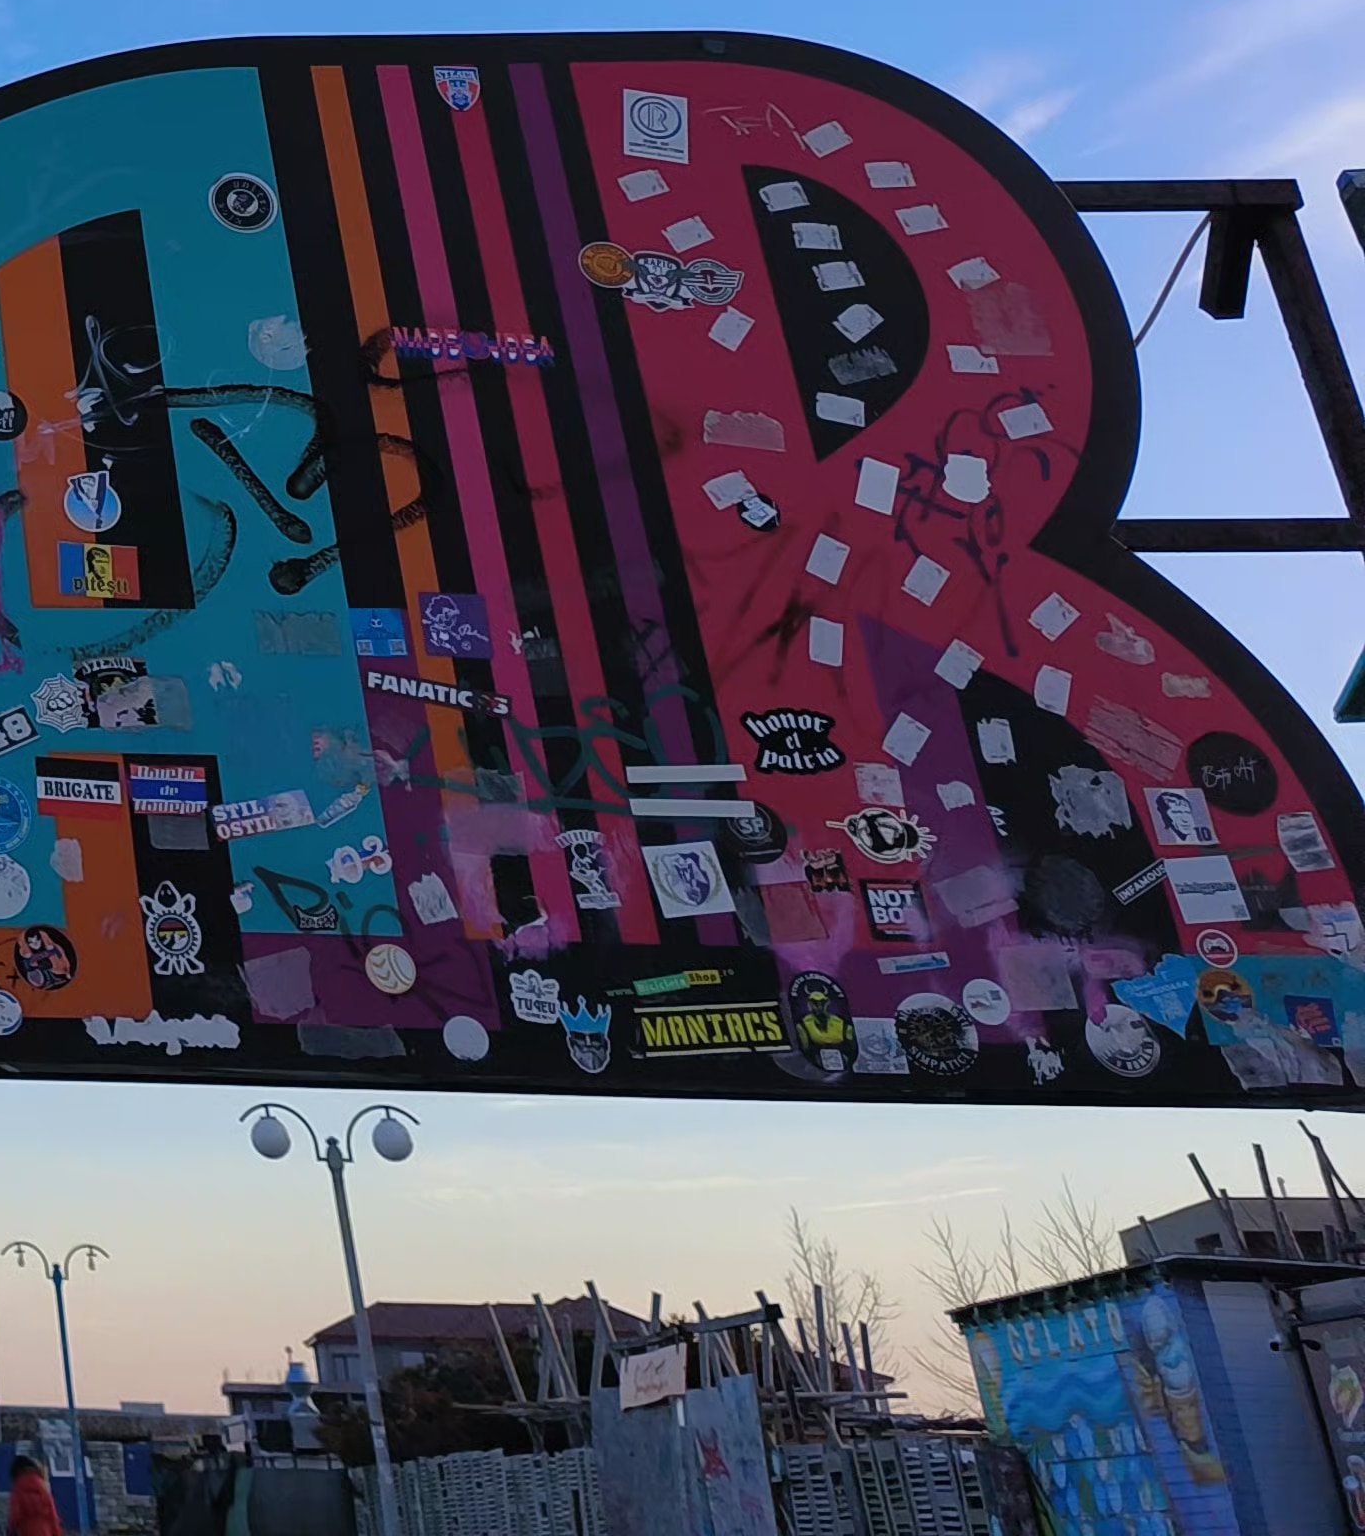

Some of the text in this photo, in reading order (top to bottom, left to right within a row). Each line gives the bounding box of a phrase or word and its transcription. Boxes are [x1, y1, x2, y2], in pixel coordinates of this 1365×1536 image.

[367, 670, 510, 721] FANATICS
[745, 711, 829, 738] honor
[43, 779, 115, 801] BRIGATE
[212, 800, 265, 822] STIL
[216, 815, 277, 840] OSTIL
[1194, 826, 1214, 842] 10
[1117, 863, 1167, 903] INFAMOUS
[867, 889, 915, 907] NOT
[638, 1010, 785, 1048] MANIACS
[909, 1044, 973, 1073] SIMPATICI
[1005, 1301, 1126, 1363] GELATO
